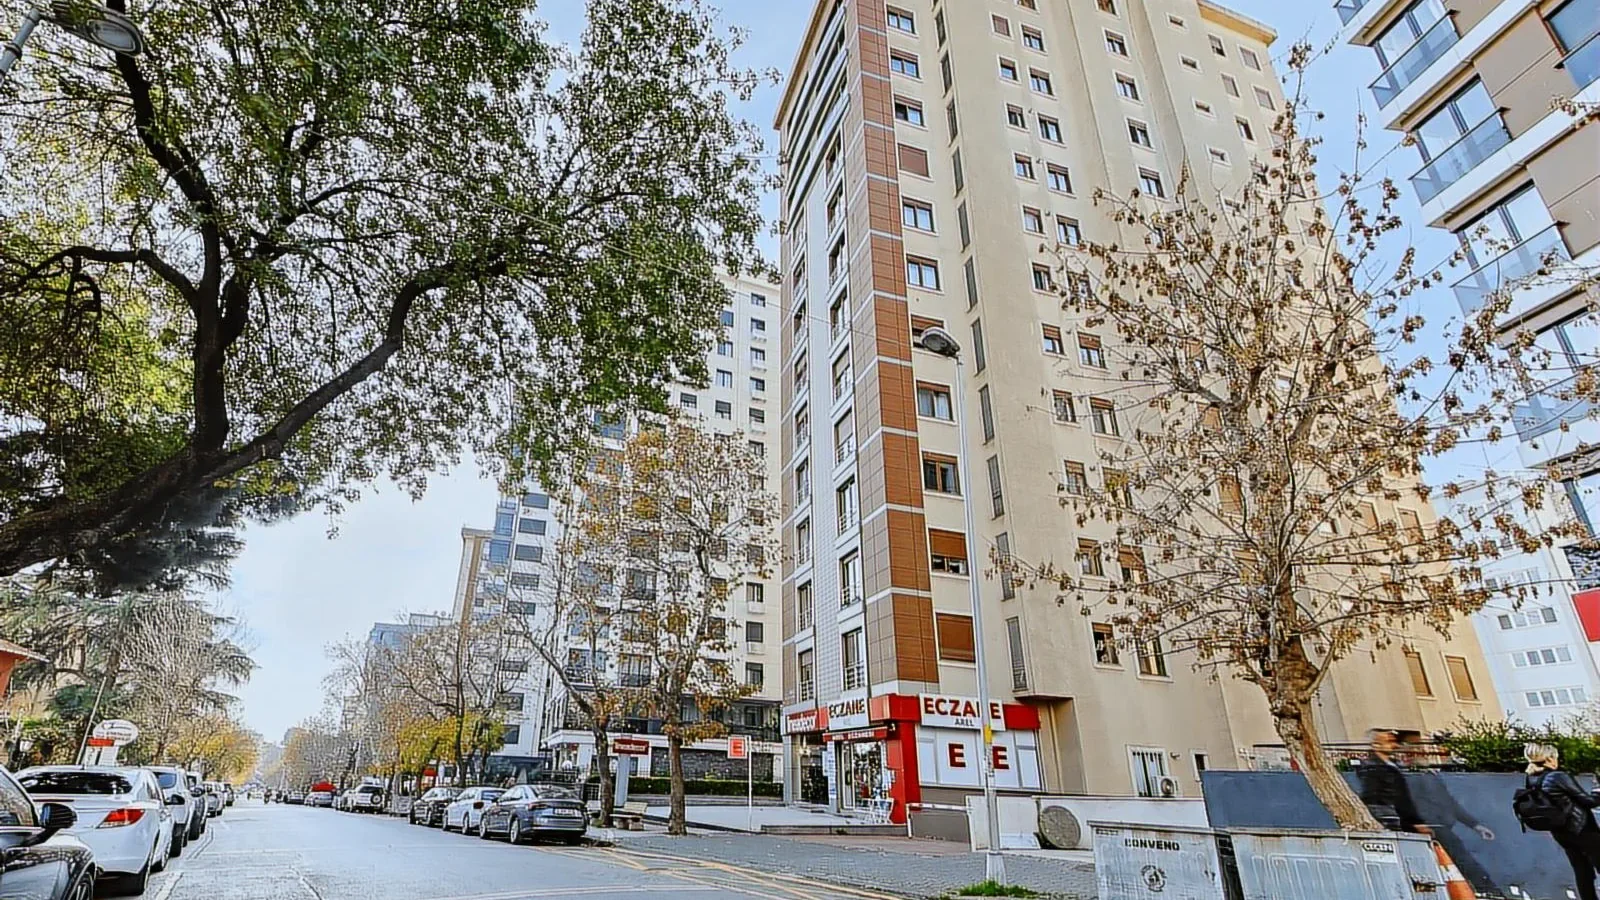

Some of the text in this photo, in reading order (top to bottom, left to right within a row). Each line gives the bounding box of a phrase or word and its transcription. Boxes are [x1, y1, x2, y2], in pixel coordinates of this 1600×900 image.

[923, 696, 1002, 720] ECZAE
[954, 718, 975, 727] AREL
[948, 743, 967, 768] E
[992, 745, 1010, 770] E
